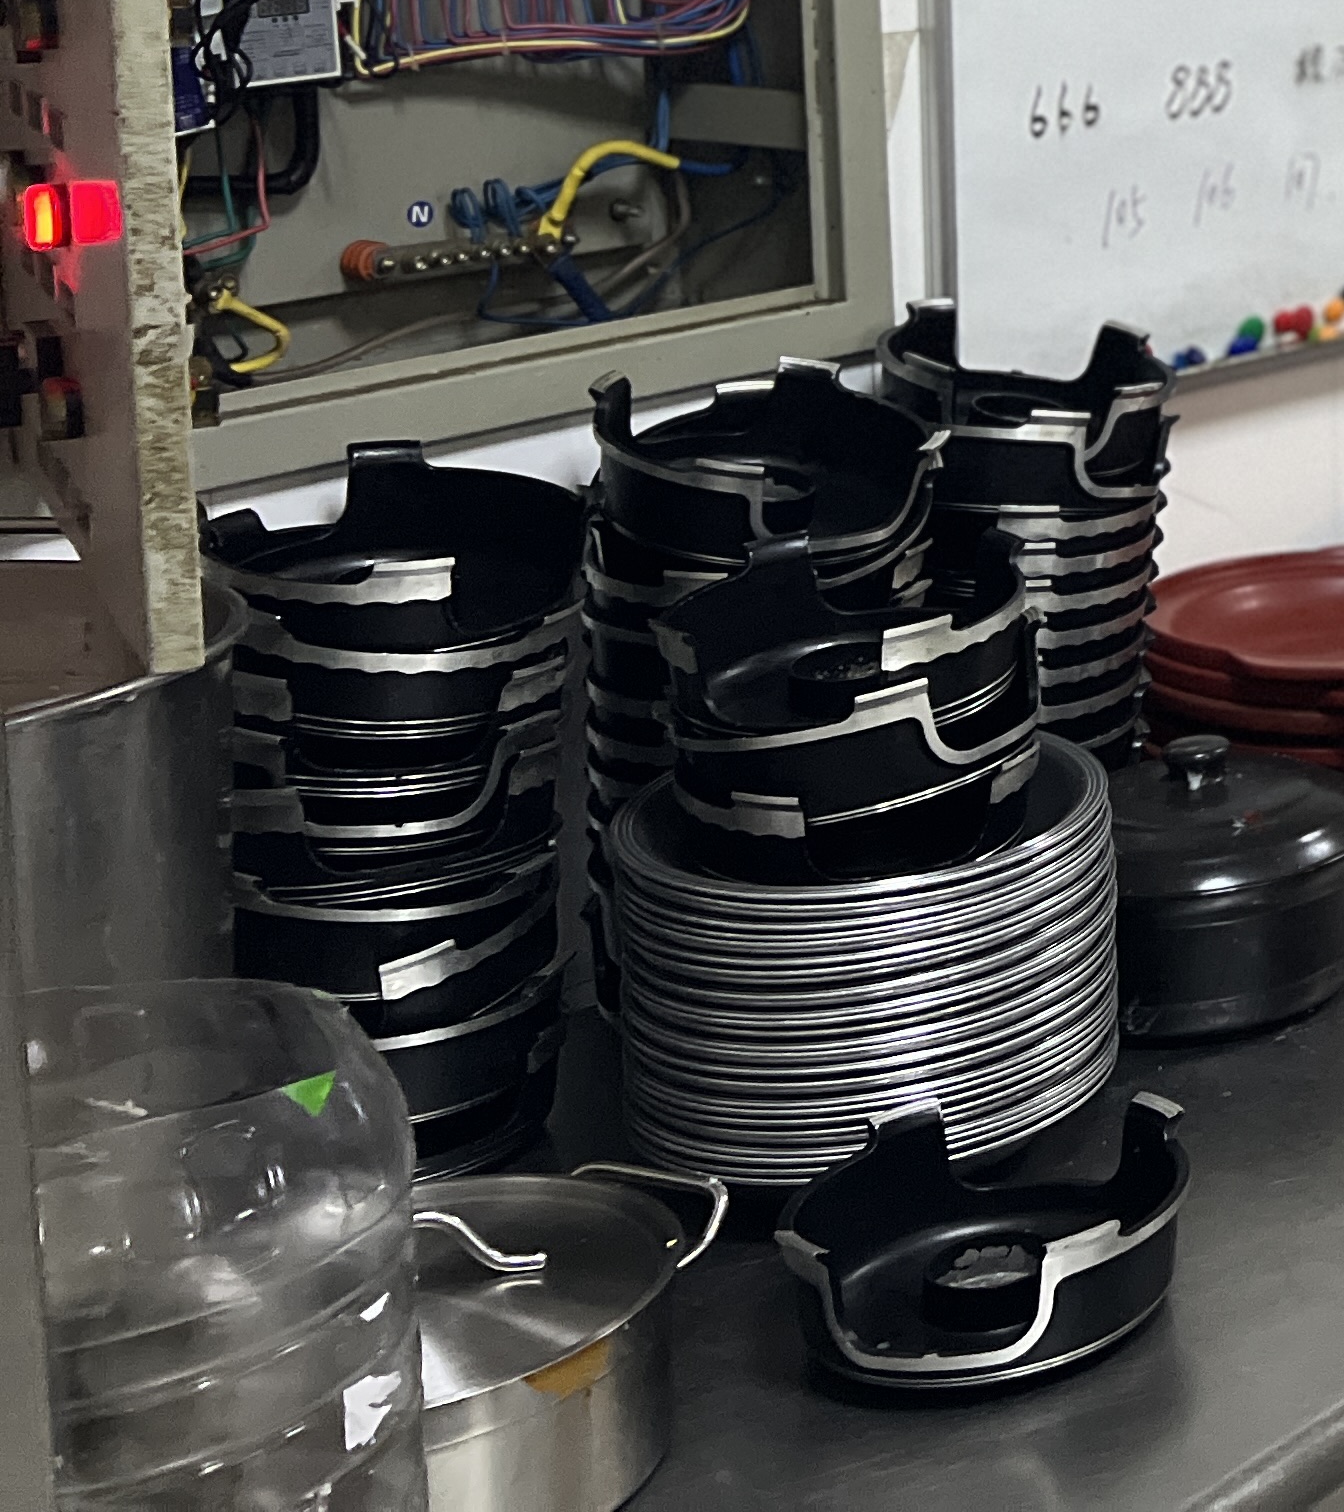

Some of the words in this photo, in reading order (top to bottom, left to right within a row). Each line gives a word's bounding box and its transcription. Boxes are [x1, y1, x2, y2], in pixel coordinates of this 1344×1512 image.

[1029, 80, 1100, 139] 666
[412, 205, 429, 223] N
[1101, 184, 1147, 249] 105
